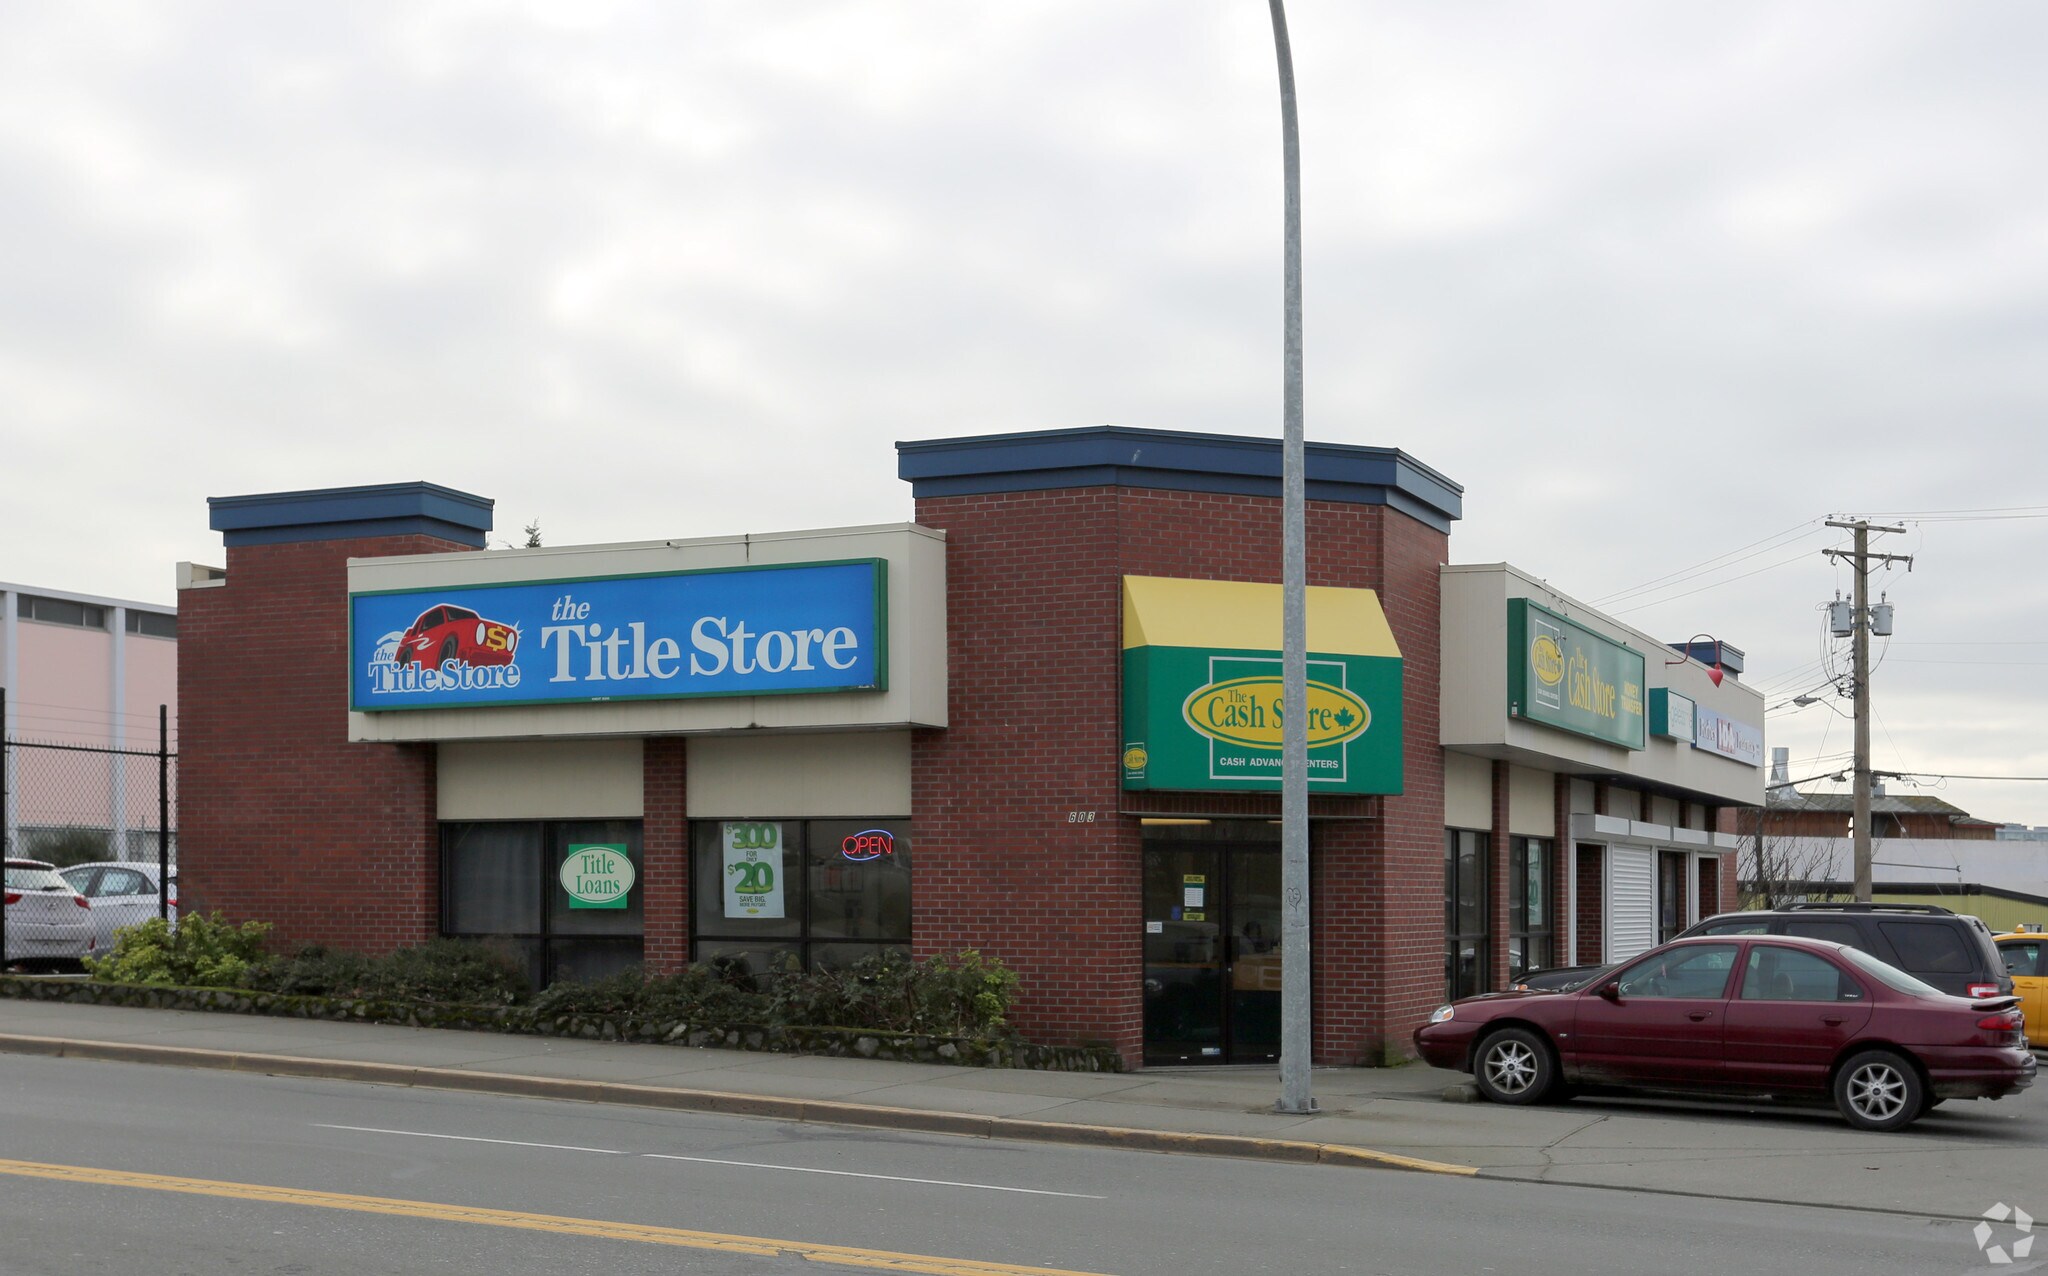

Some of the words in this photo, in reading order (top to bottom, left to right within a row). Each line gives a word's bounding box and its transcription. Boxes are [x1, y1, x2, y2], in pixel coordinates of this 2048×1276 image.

[551, 595, 590, 622] the
[375, 649, 394, 661] the
[541, 622, 681, 683] Title
[690, 616, 858, 676] Store
[368, 661, 438, 694] Title
[439, 658, 520, 690] Store
[1228, 689, 1247, 703] The
[1568, 656, 1591, 711] Cash
[1593, 666, 1616, 719] Store
[1208, 695, 1266, 728] Cash
[1272, 698, 1332, 731] Sre
[1220, 757, 1246, 767] CASH
[1249, 758, 1284, 767] ADVAN
[1305, 759, 1339, 769] ENTERS
[1069, 811, 1096, 823] 603
[725, 822, 778, 849] $300
[842, 836, 893, 855] OPEN
[581, 853, 615, 875] Title
[576, 875, 621, 895] Loans
[727, 861, 774, 894] $20
[739, 895, 754, 903] SAVE
